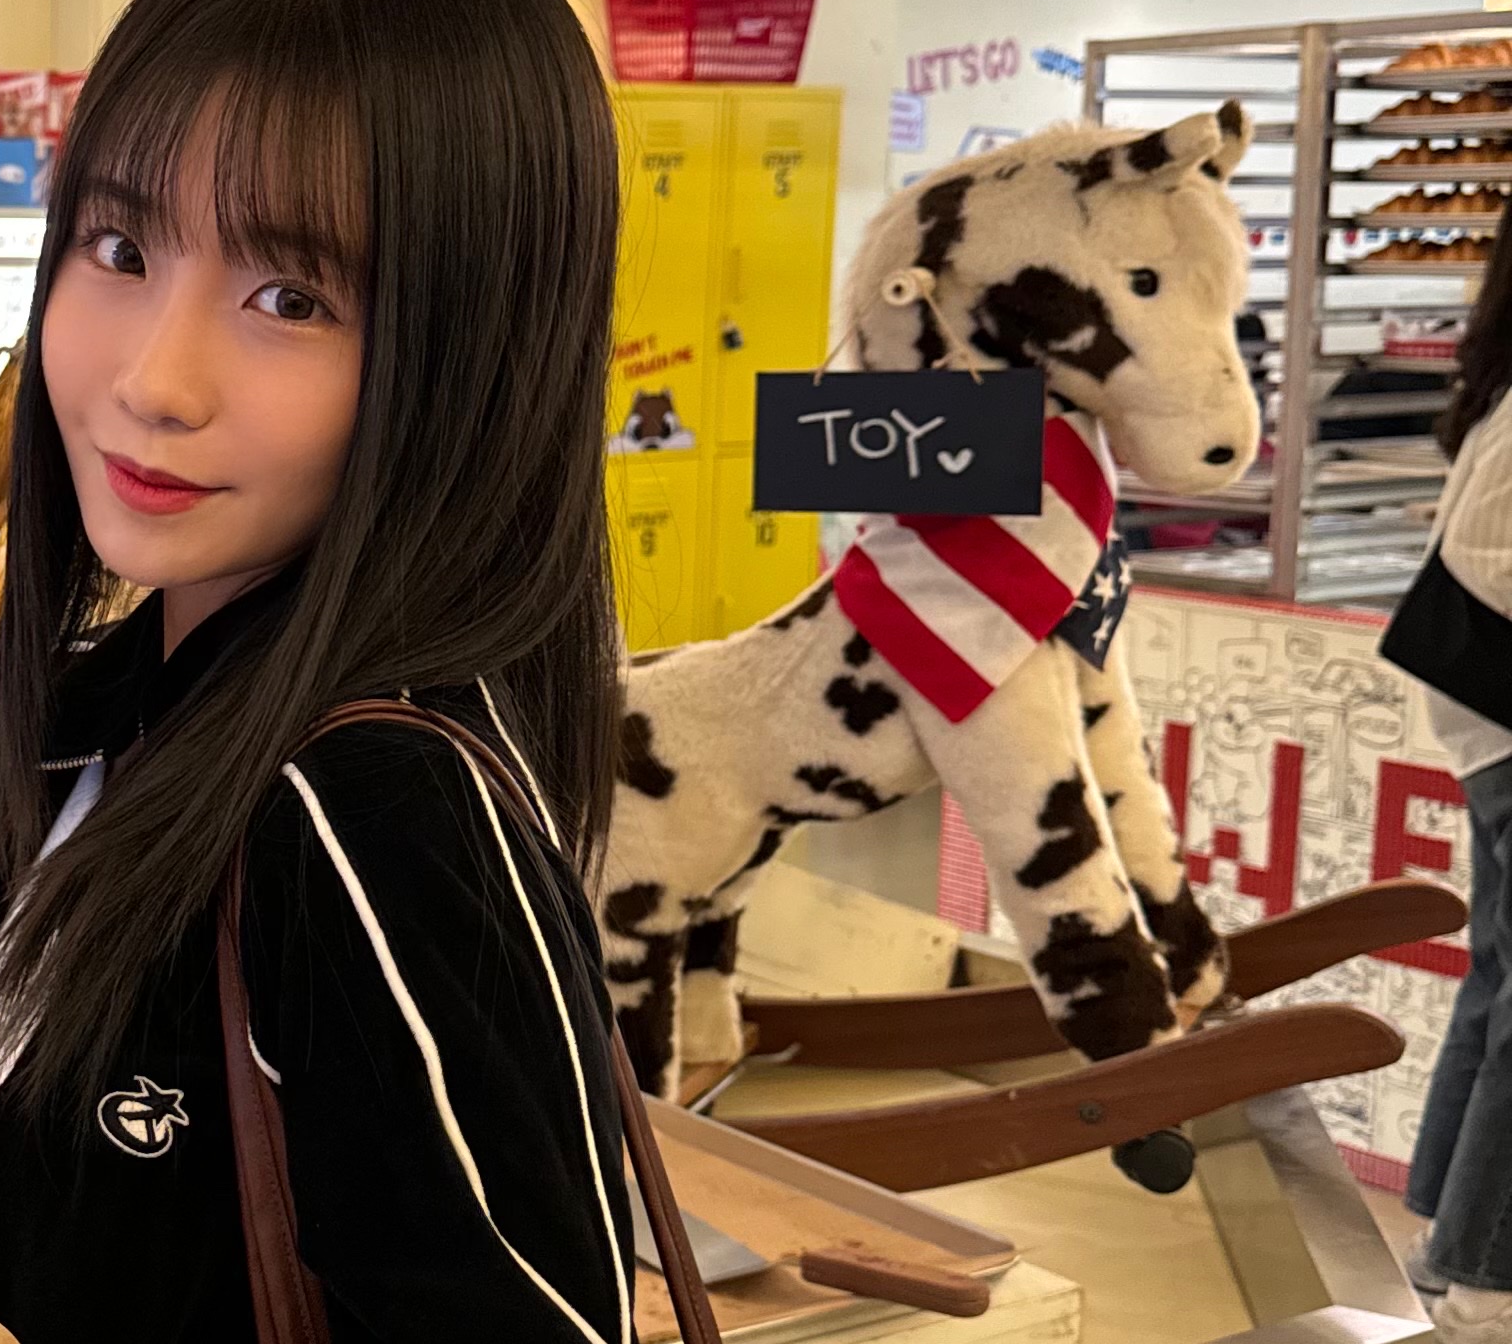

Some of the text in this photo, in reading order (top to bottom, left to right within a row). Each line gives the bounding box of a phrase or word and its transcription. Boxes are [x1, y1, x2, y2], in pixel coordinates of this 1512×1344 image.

[983, 38, 1021, 83] GO
[654, 172, 671, 198] 4
[797, 408, 946, 479] TOY
